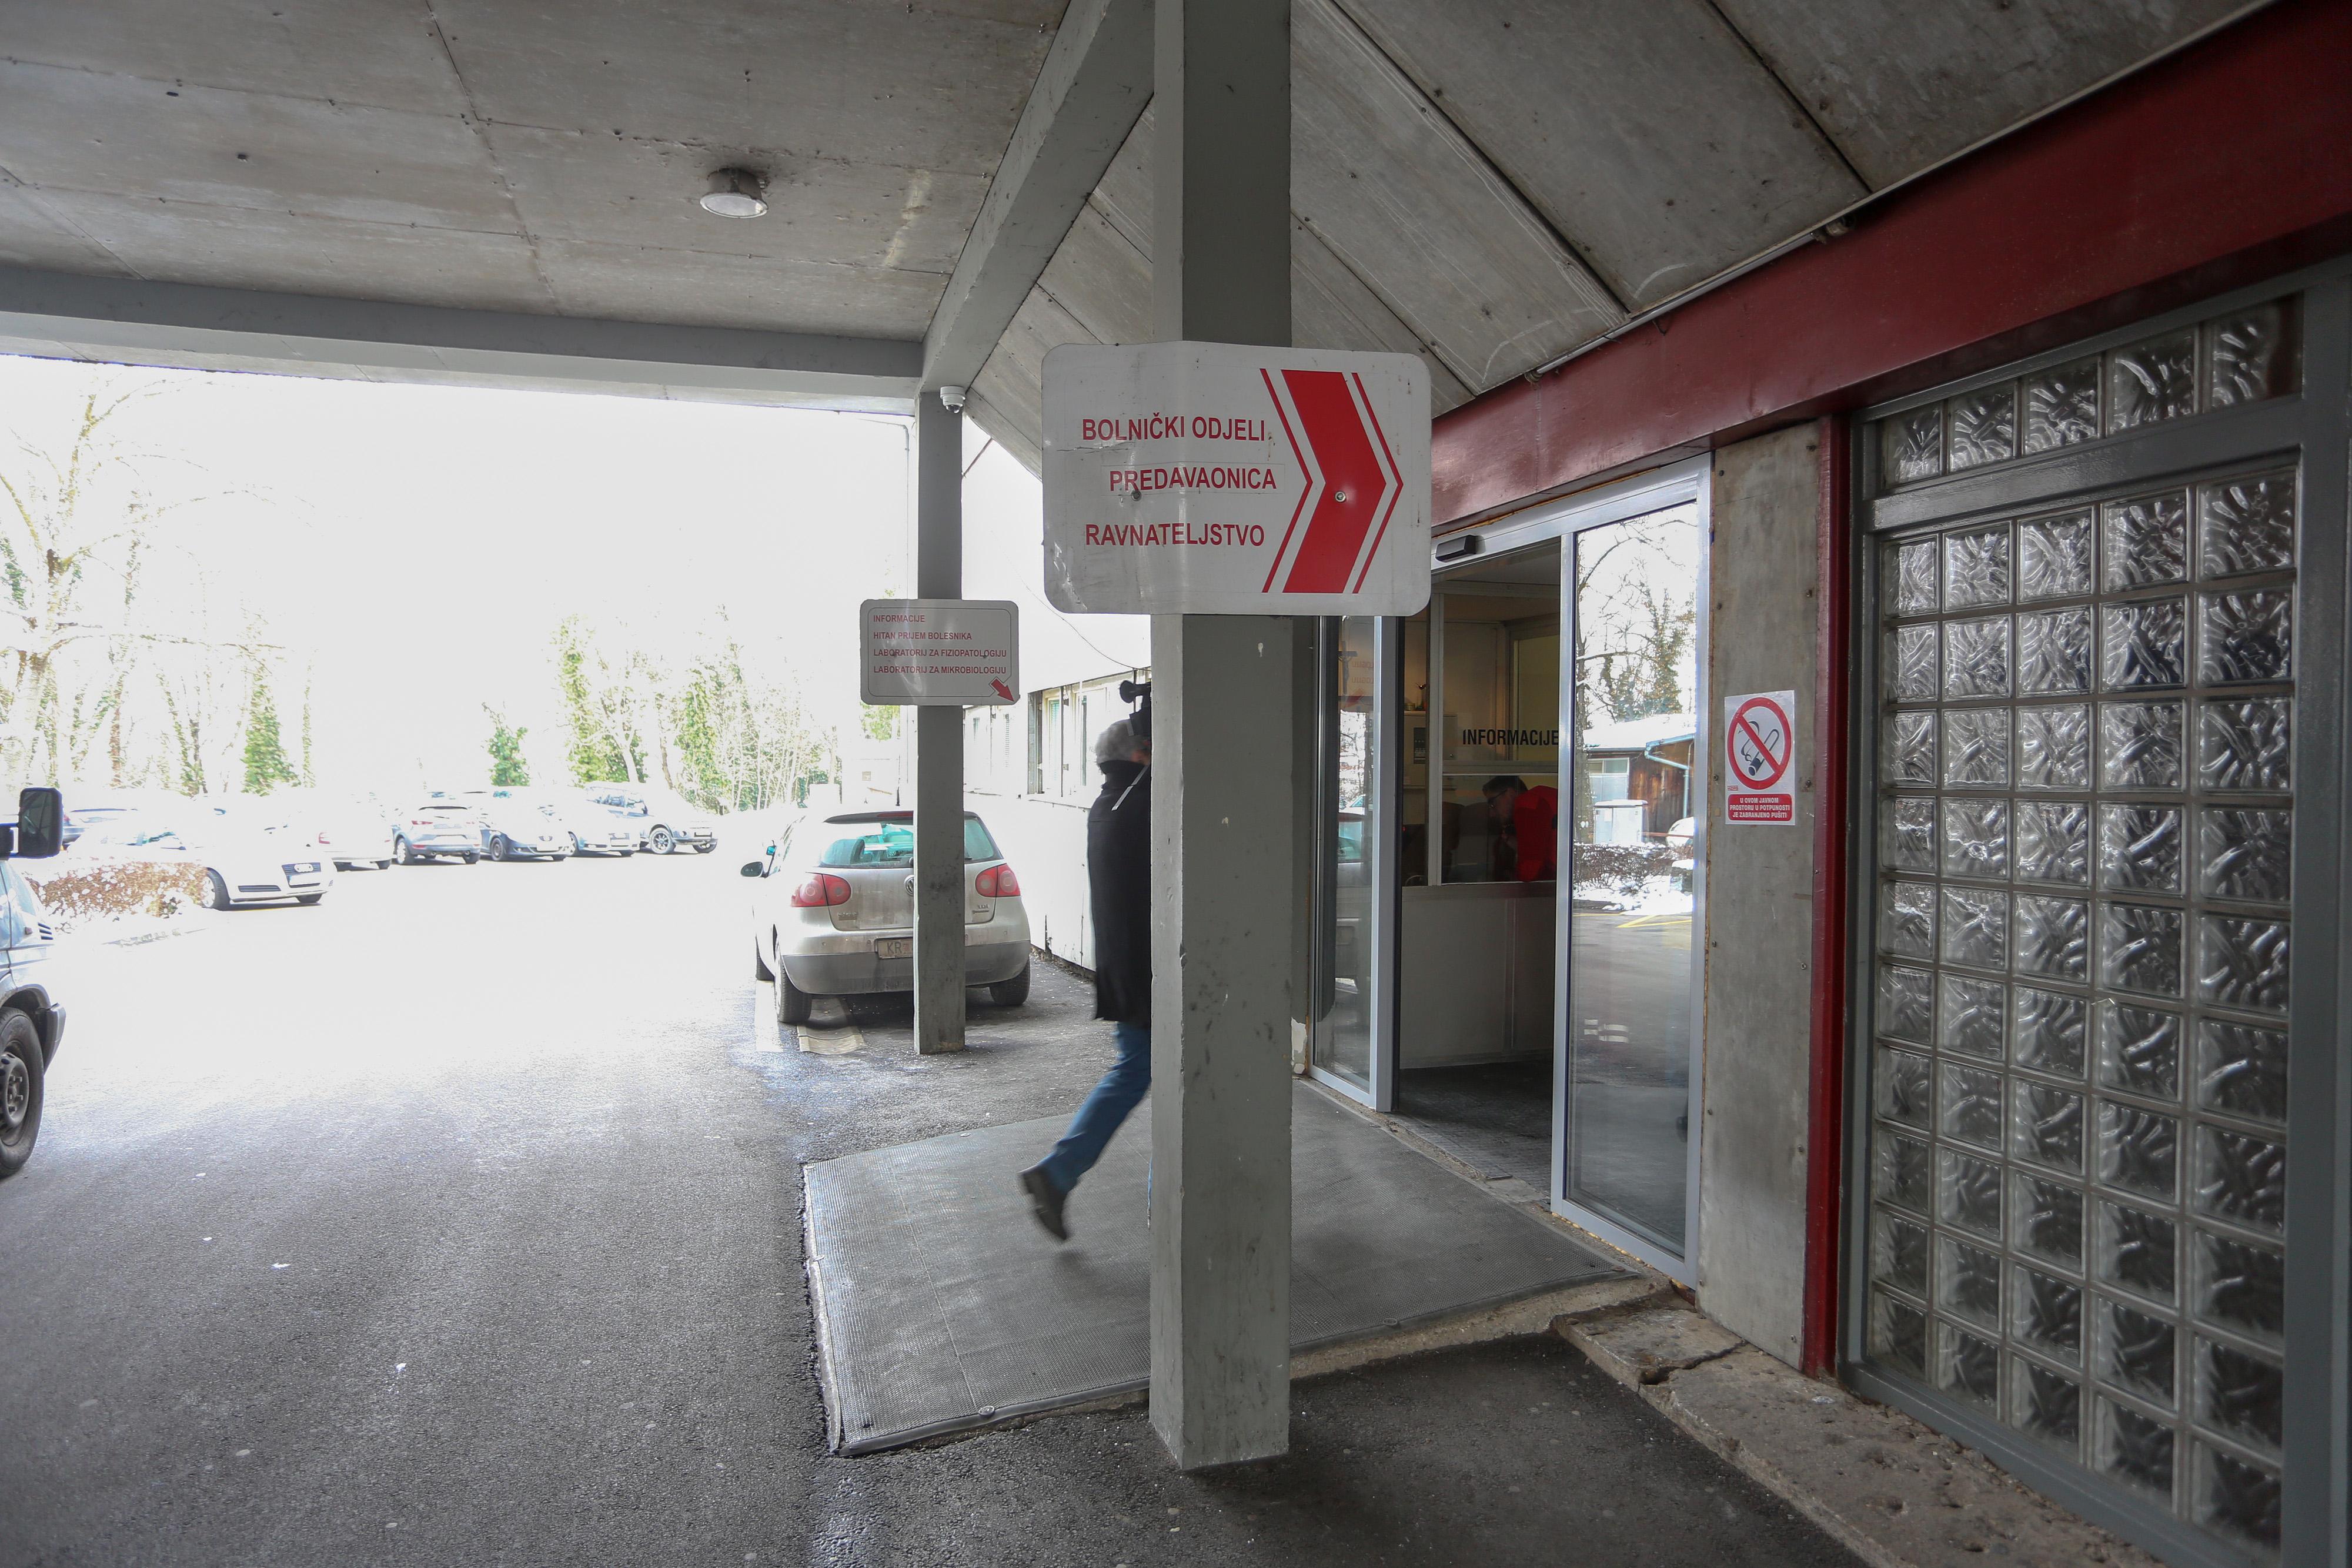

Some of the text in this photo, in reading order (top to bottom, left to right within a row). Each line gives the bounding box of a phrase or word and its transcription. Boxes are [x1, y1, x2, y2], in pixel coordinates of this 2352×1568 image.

[1082, 412, 1265, 441] BOLNIČKI ODJELI
[1110, 467, 1277, 491] PREDAVAONICA
[1085, 523, 1265, 546] RAVNATELJSTVO
[941, 649, 1007, 657] FIZIOPATOLOGIJU
[873, 666, 1007, 674] LABORATORIJ ZA MIKROBIOLOGIJU
[1462, 729, 1559, 745] INFORMACIJE
[887, 941, 903, 954] KR
